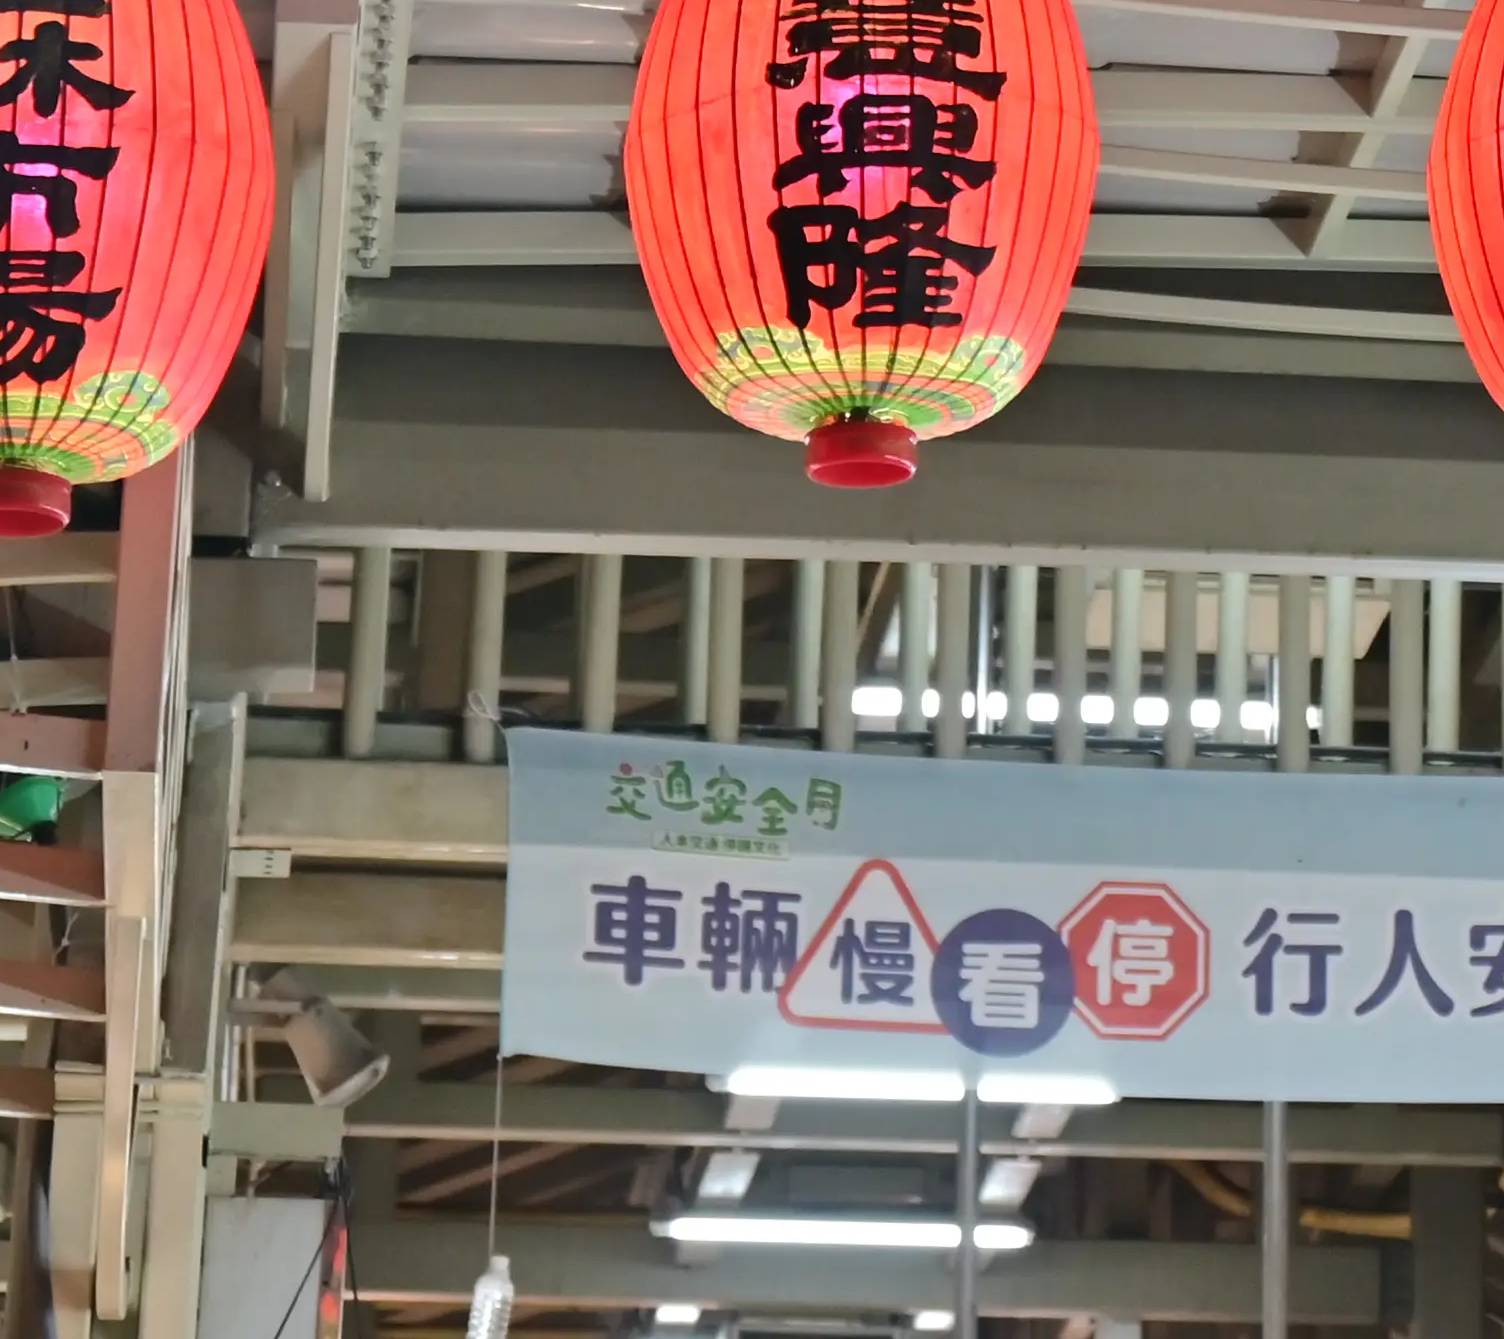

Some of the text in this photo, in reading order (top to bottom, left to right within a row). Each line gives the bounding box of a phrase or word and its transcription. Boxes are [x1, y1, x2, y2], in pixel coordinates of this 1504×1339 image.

[606, 760, 841, 835] 交通安全月
